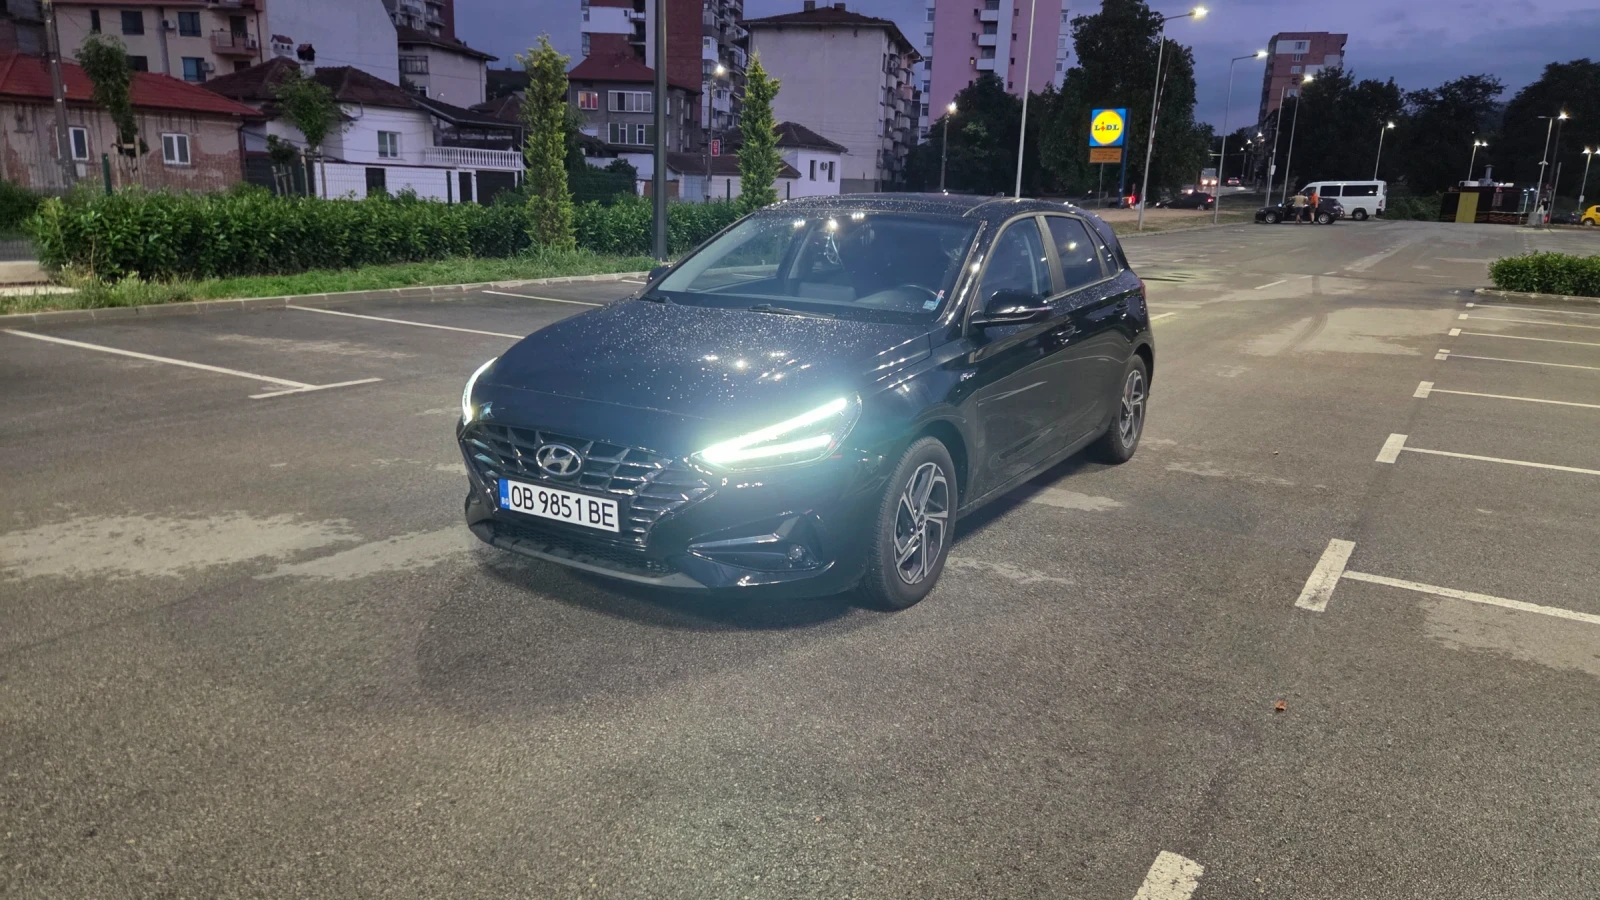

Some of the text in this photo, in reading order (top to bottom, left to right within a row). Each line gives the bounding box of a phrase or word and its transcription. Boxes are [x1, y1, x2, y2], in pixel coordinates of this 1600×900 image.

[501, 497, 510, 505] BG
[511, 485, 615, 527] OB 9851 BE
